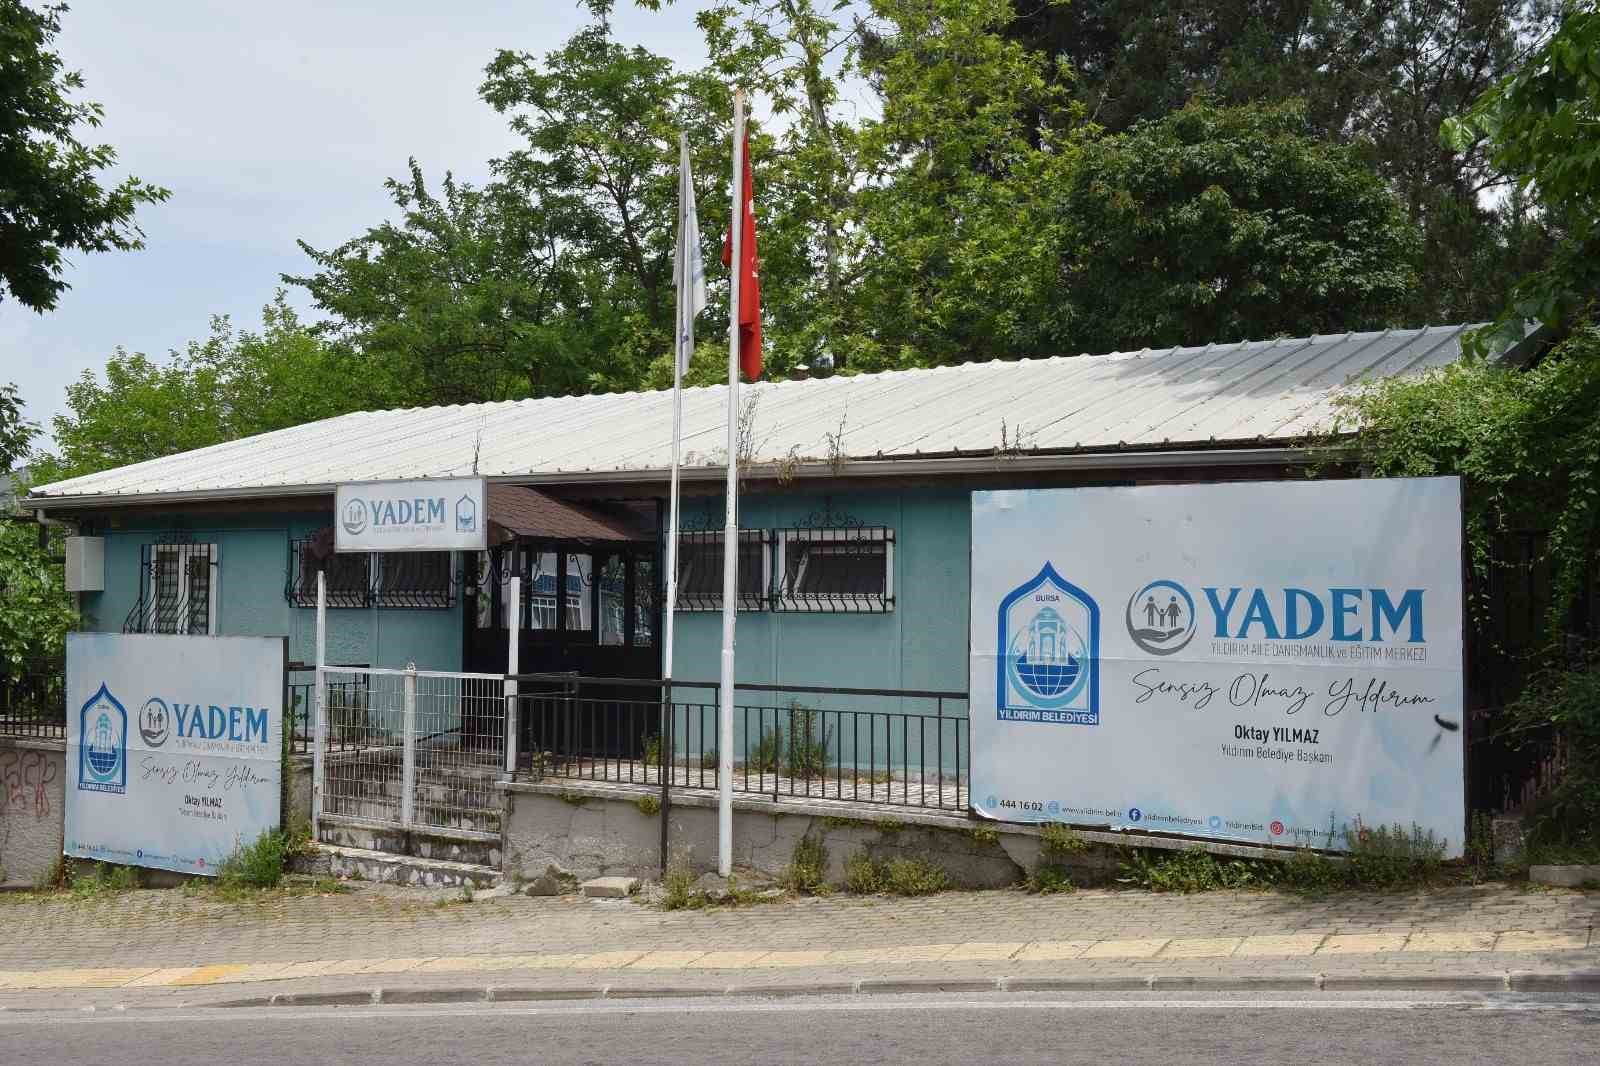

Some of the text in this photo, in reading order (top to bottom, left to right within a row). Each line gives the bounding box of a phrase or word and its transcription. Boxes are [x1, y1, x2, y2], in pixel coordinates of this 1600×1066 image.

[370, 498, 446, 526] YADEM
[1035, 594, 1060, 602] BURSA
[1201, 587, 1428, 643] YADEM
[1132, 668, 1221, 709] Sensiz
[1229, 672, 1315, 715] Olmaz
[172, 703, 269, 743] YADEM
[999, 709, 1097, 724] YILDIRIM BELEDİYESİ
[1234, 724, 1321, 745] Oktay YILMAZ
[999, 800, 1043, 811] 444 16 02
